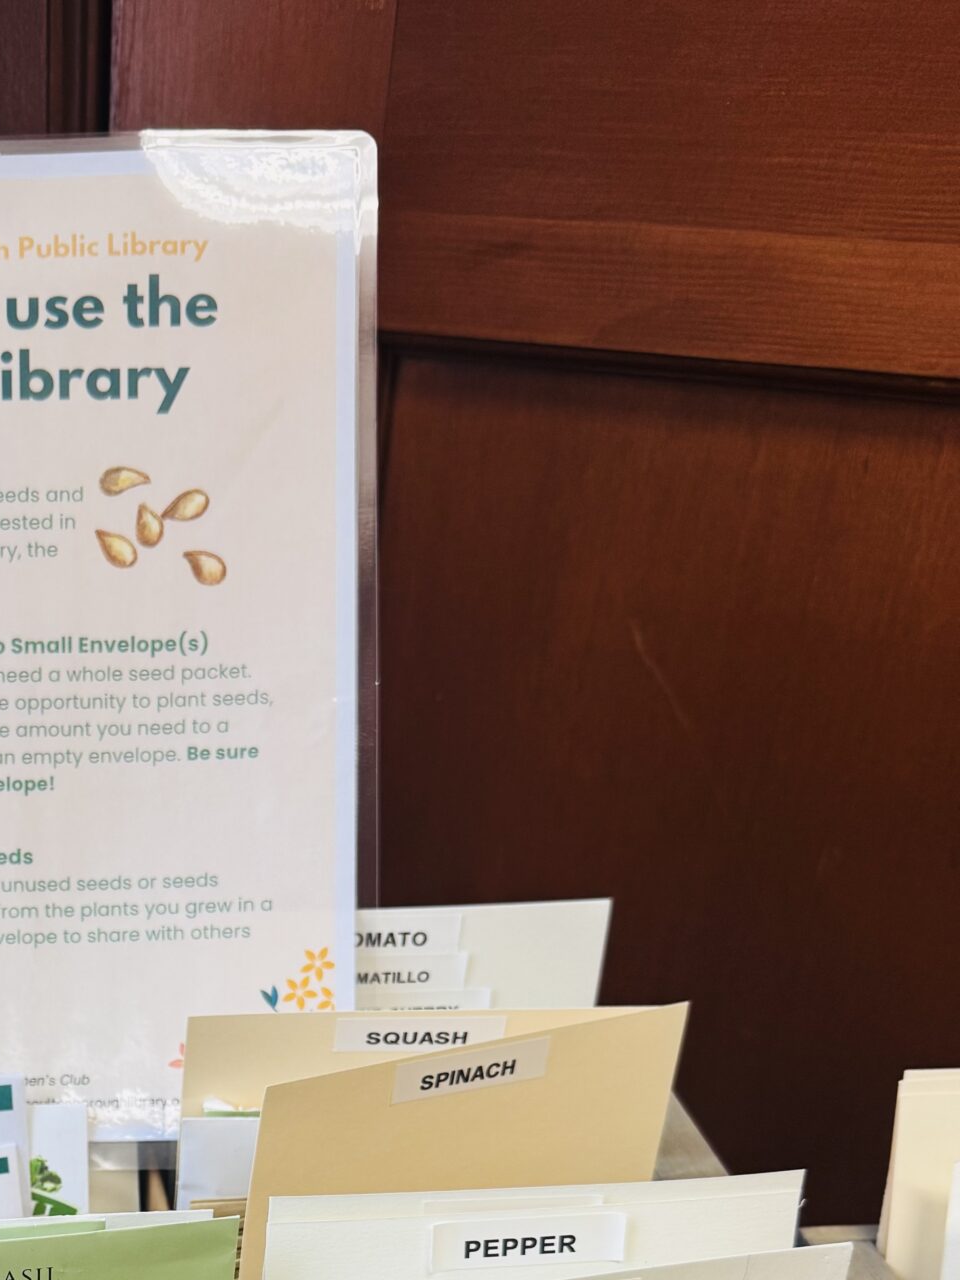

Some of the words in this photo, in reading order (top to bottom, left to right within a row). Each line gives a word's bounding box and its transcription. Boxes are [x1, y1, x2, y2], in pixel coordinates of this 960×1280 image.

[17, 234, 100, 261] Public
[108, 231, 208, 263] Library
[5, 287, 105, 331] use
[122, 274, 218, 328] the
[46, 485, 84, 503] and
[60, 513, 76, 530] in
[28, 542, 58, 557] the
[11, 636, 72, 654] Small
[78, 631, 208, 658] Envelope(s)
[48, 669, 60, 682] a
[67, 666, 123, 682] whole
[129, 665, 175, 681] seed
[181, 664, 251, 685] packet.
[15, 693, 126, 715] opportunity
[132, 694, 150, 709] to
[157, 692, 206, 712] plant
[212, 690, 273, 707] seeds,
[366, 1032, 468, 1046] SQUASH
[60, 1074, 90, 1086] Club
[420, 1059, 516, 1091] SPINACH
[464, 1234, 576, 1260] PEPPER
